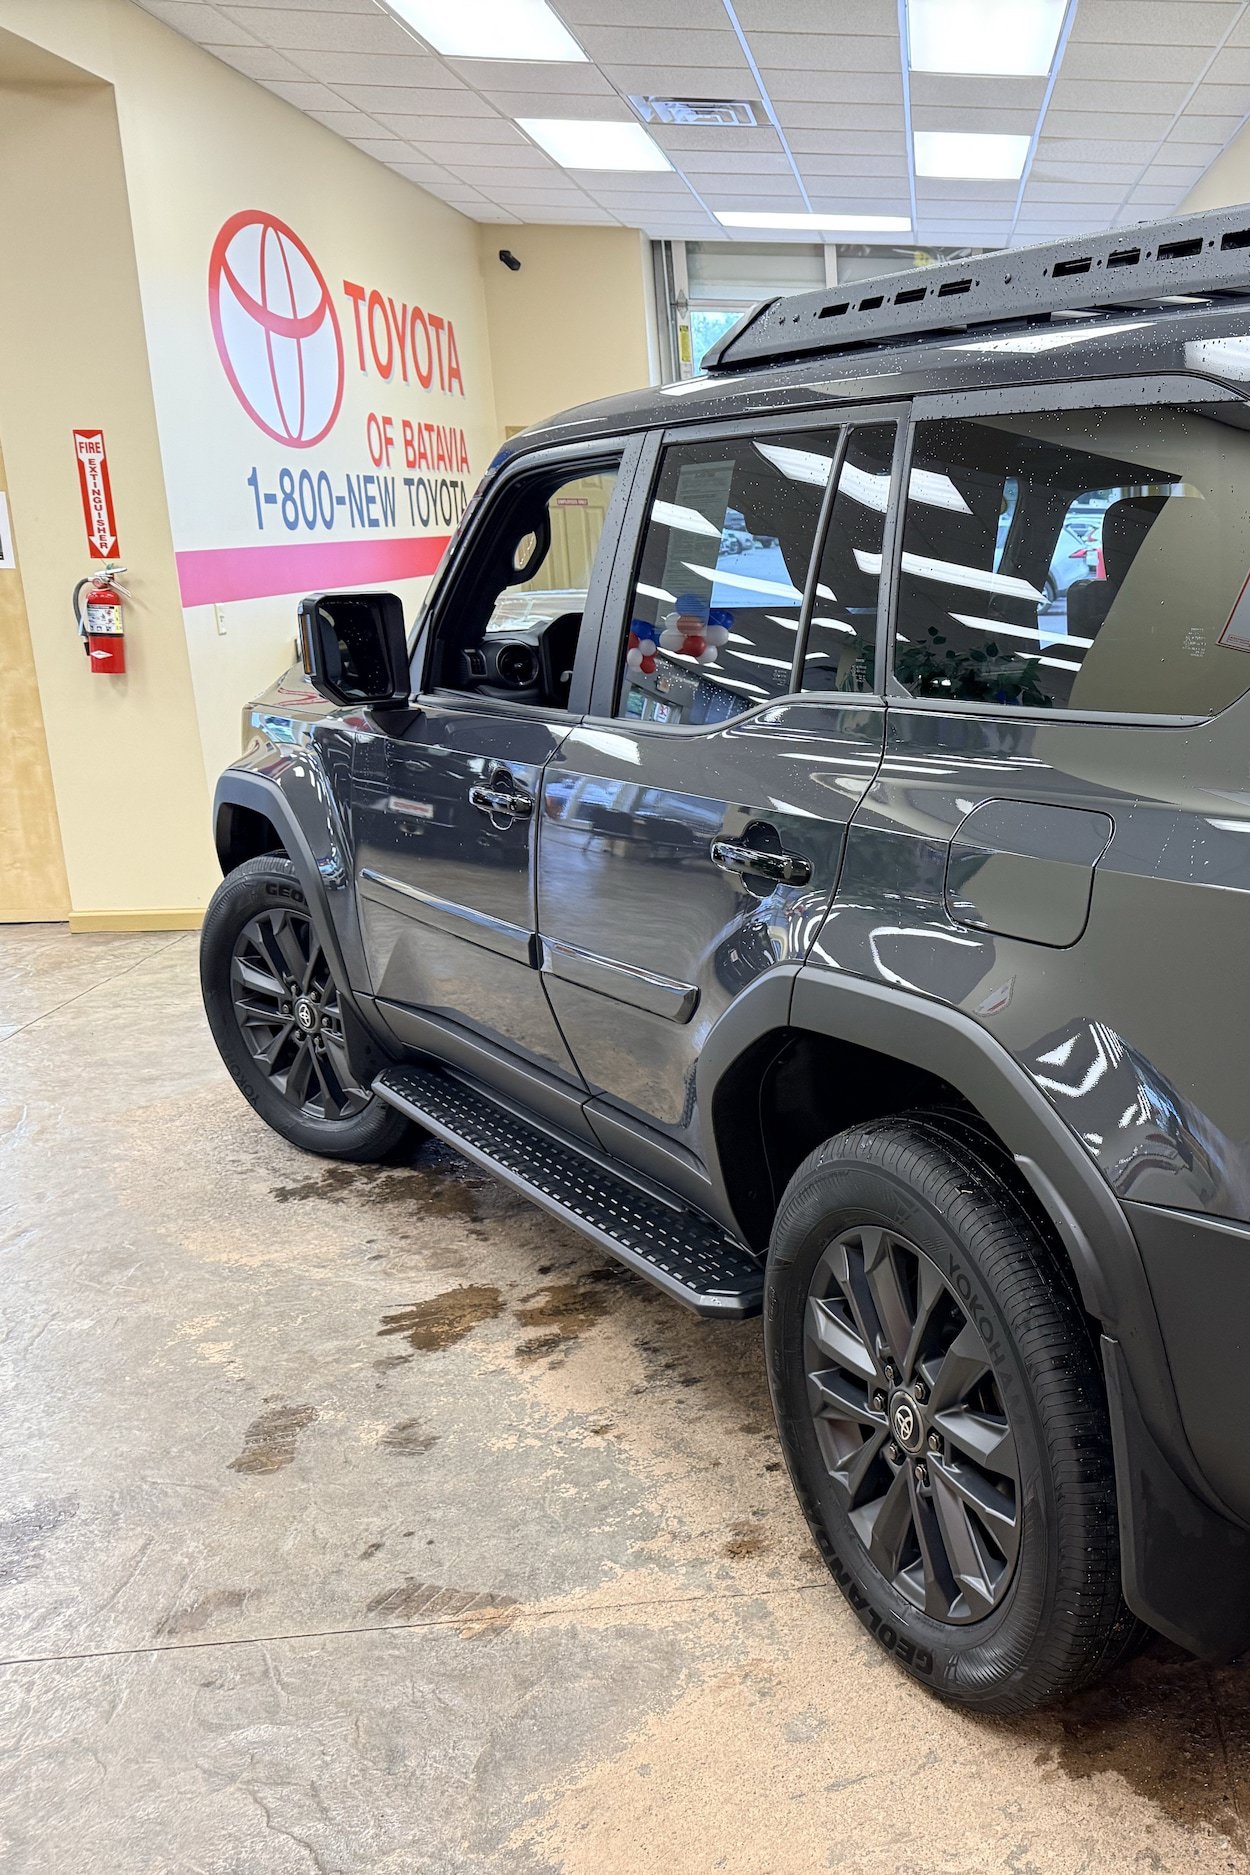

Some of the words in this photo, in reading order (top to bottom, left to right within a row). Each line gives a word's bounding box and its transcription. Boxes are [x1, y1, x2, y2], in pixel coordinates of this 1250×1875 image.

[343, 279, 465, 397] TOYOTA
[78, 441, 102, 454] FIRE
[367, 412, 394, 468] OF
[402, 419, 470, 473] BATAVIA
[88, 458, 109, 549] EXTINGUISHER
[247, 466, 397, 532] 1-800-NEW
[404, 477, 468, 528] TOYOTA
[949, 1254, 1027, 1428] YOKOHAM
